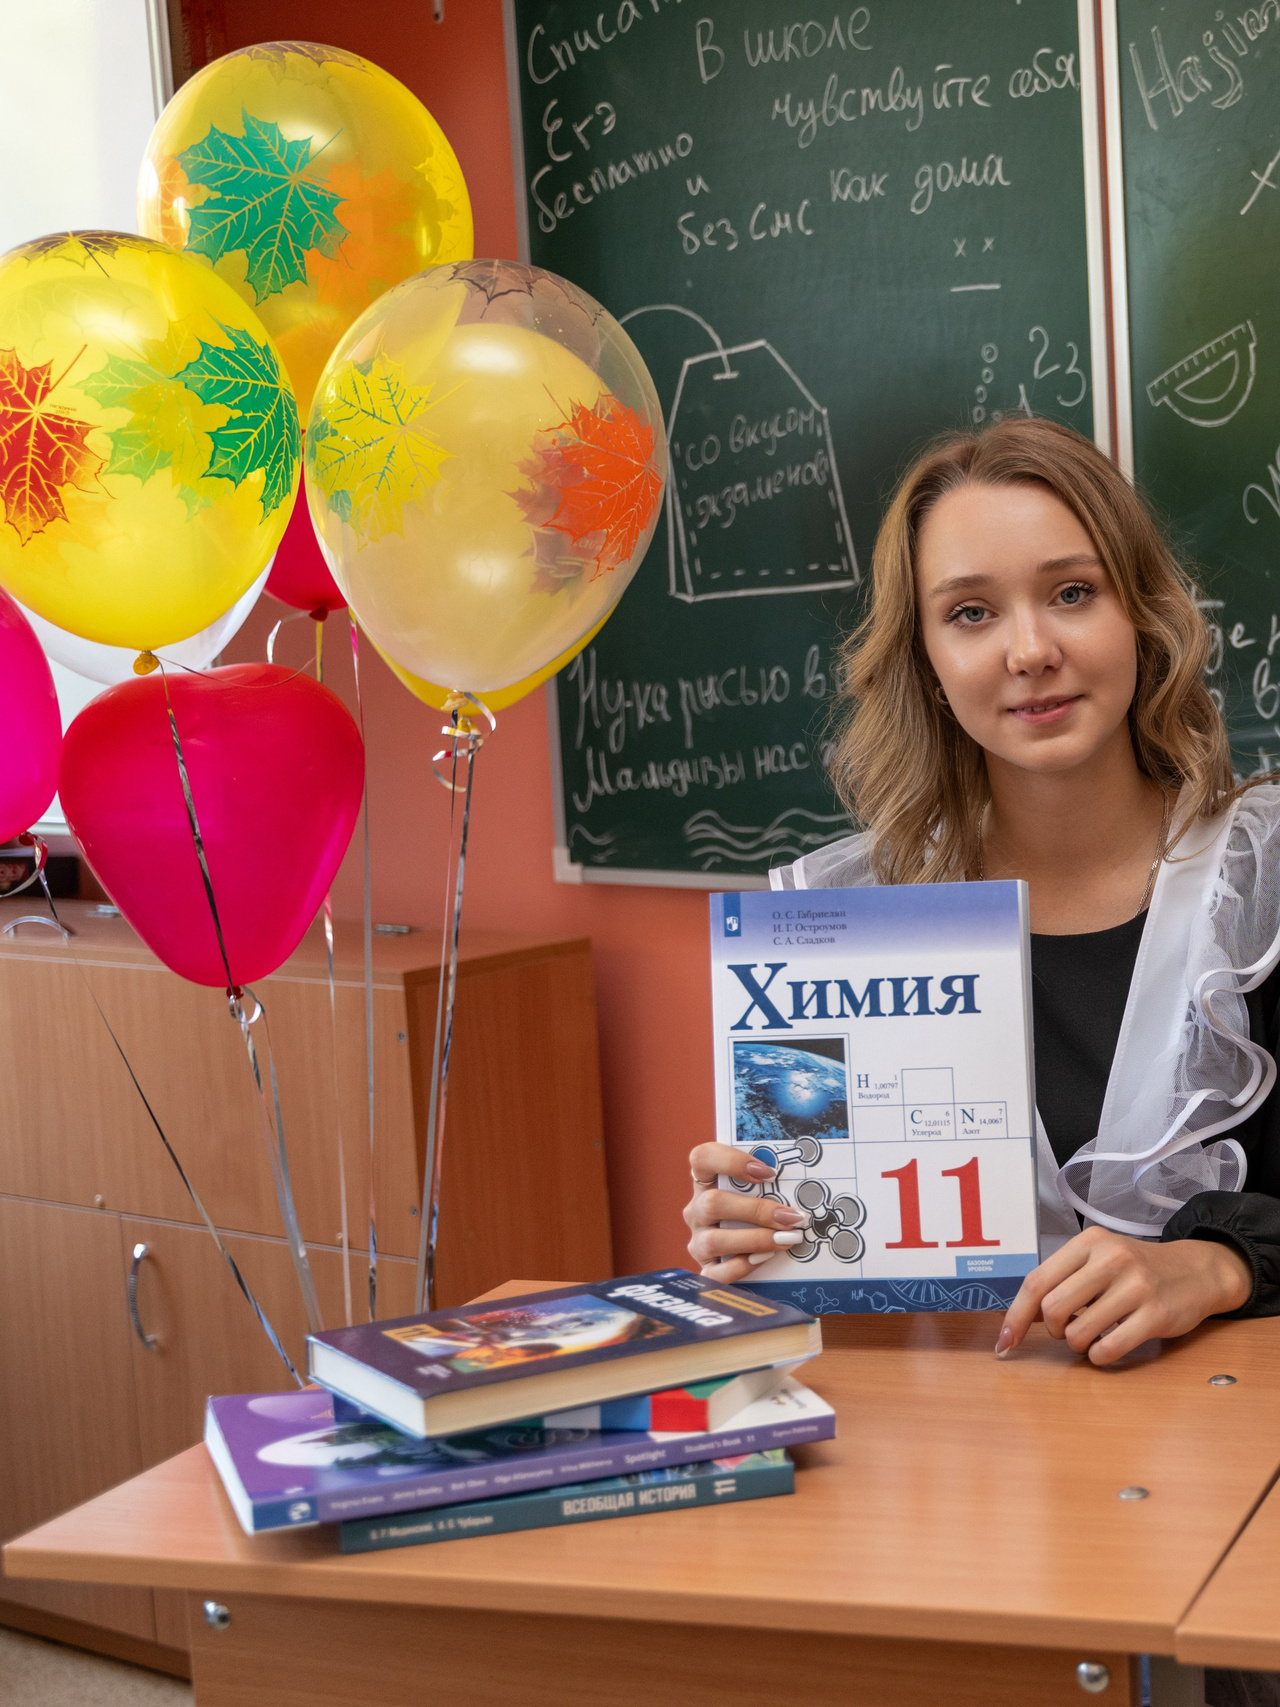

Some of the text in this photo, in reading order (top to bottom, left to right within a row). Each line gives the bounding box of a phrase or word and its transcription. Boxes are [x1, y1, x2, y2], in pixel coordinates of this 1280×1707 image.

[527, 0, 683, 84] Списа
[696, 5, 873, 84] В школе
[772, 64, 991, 148] чувствуйте
[686, 174, 710, 197] и
[911, 153, 1011, 214] дома
[677, 211, 739, 256] без
[685, 407, 815, 472] со вкусом
[696, 449, 828, 529] экзаменов
[572, 745, 746, 812] Мальдивы
[753, 742, 811, 780] нас
[795, 922, 847, 934] Остроумов
[797, 909, 846, 921] Габриелян
[796, 936, 835, 946] Сладков
[858, 1092, 890, 1100] Водород
[924, 1119, 950, 1127] 12,01115
[960, 1108, 975, 1124] N
[912, 1129, 941, 1137] Углерод
[881, 1156, 1001, 1249] 11
[967, 1259, 994, 1267] БАЗОВЫЙ
[967, 1265, 993, 1273] УРОВЕНЬ
[625, 1450, 667, 1464] Spotlight
[684, 1439, 722, 1454] Student's
[722, 1437, 742, 1448] Book
[563, 1478, 736, 1516] ВСЕОБЩАЯ ИСТОРИЯ 11
